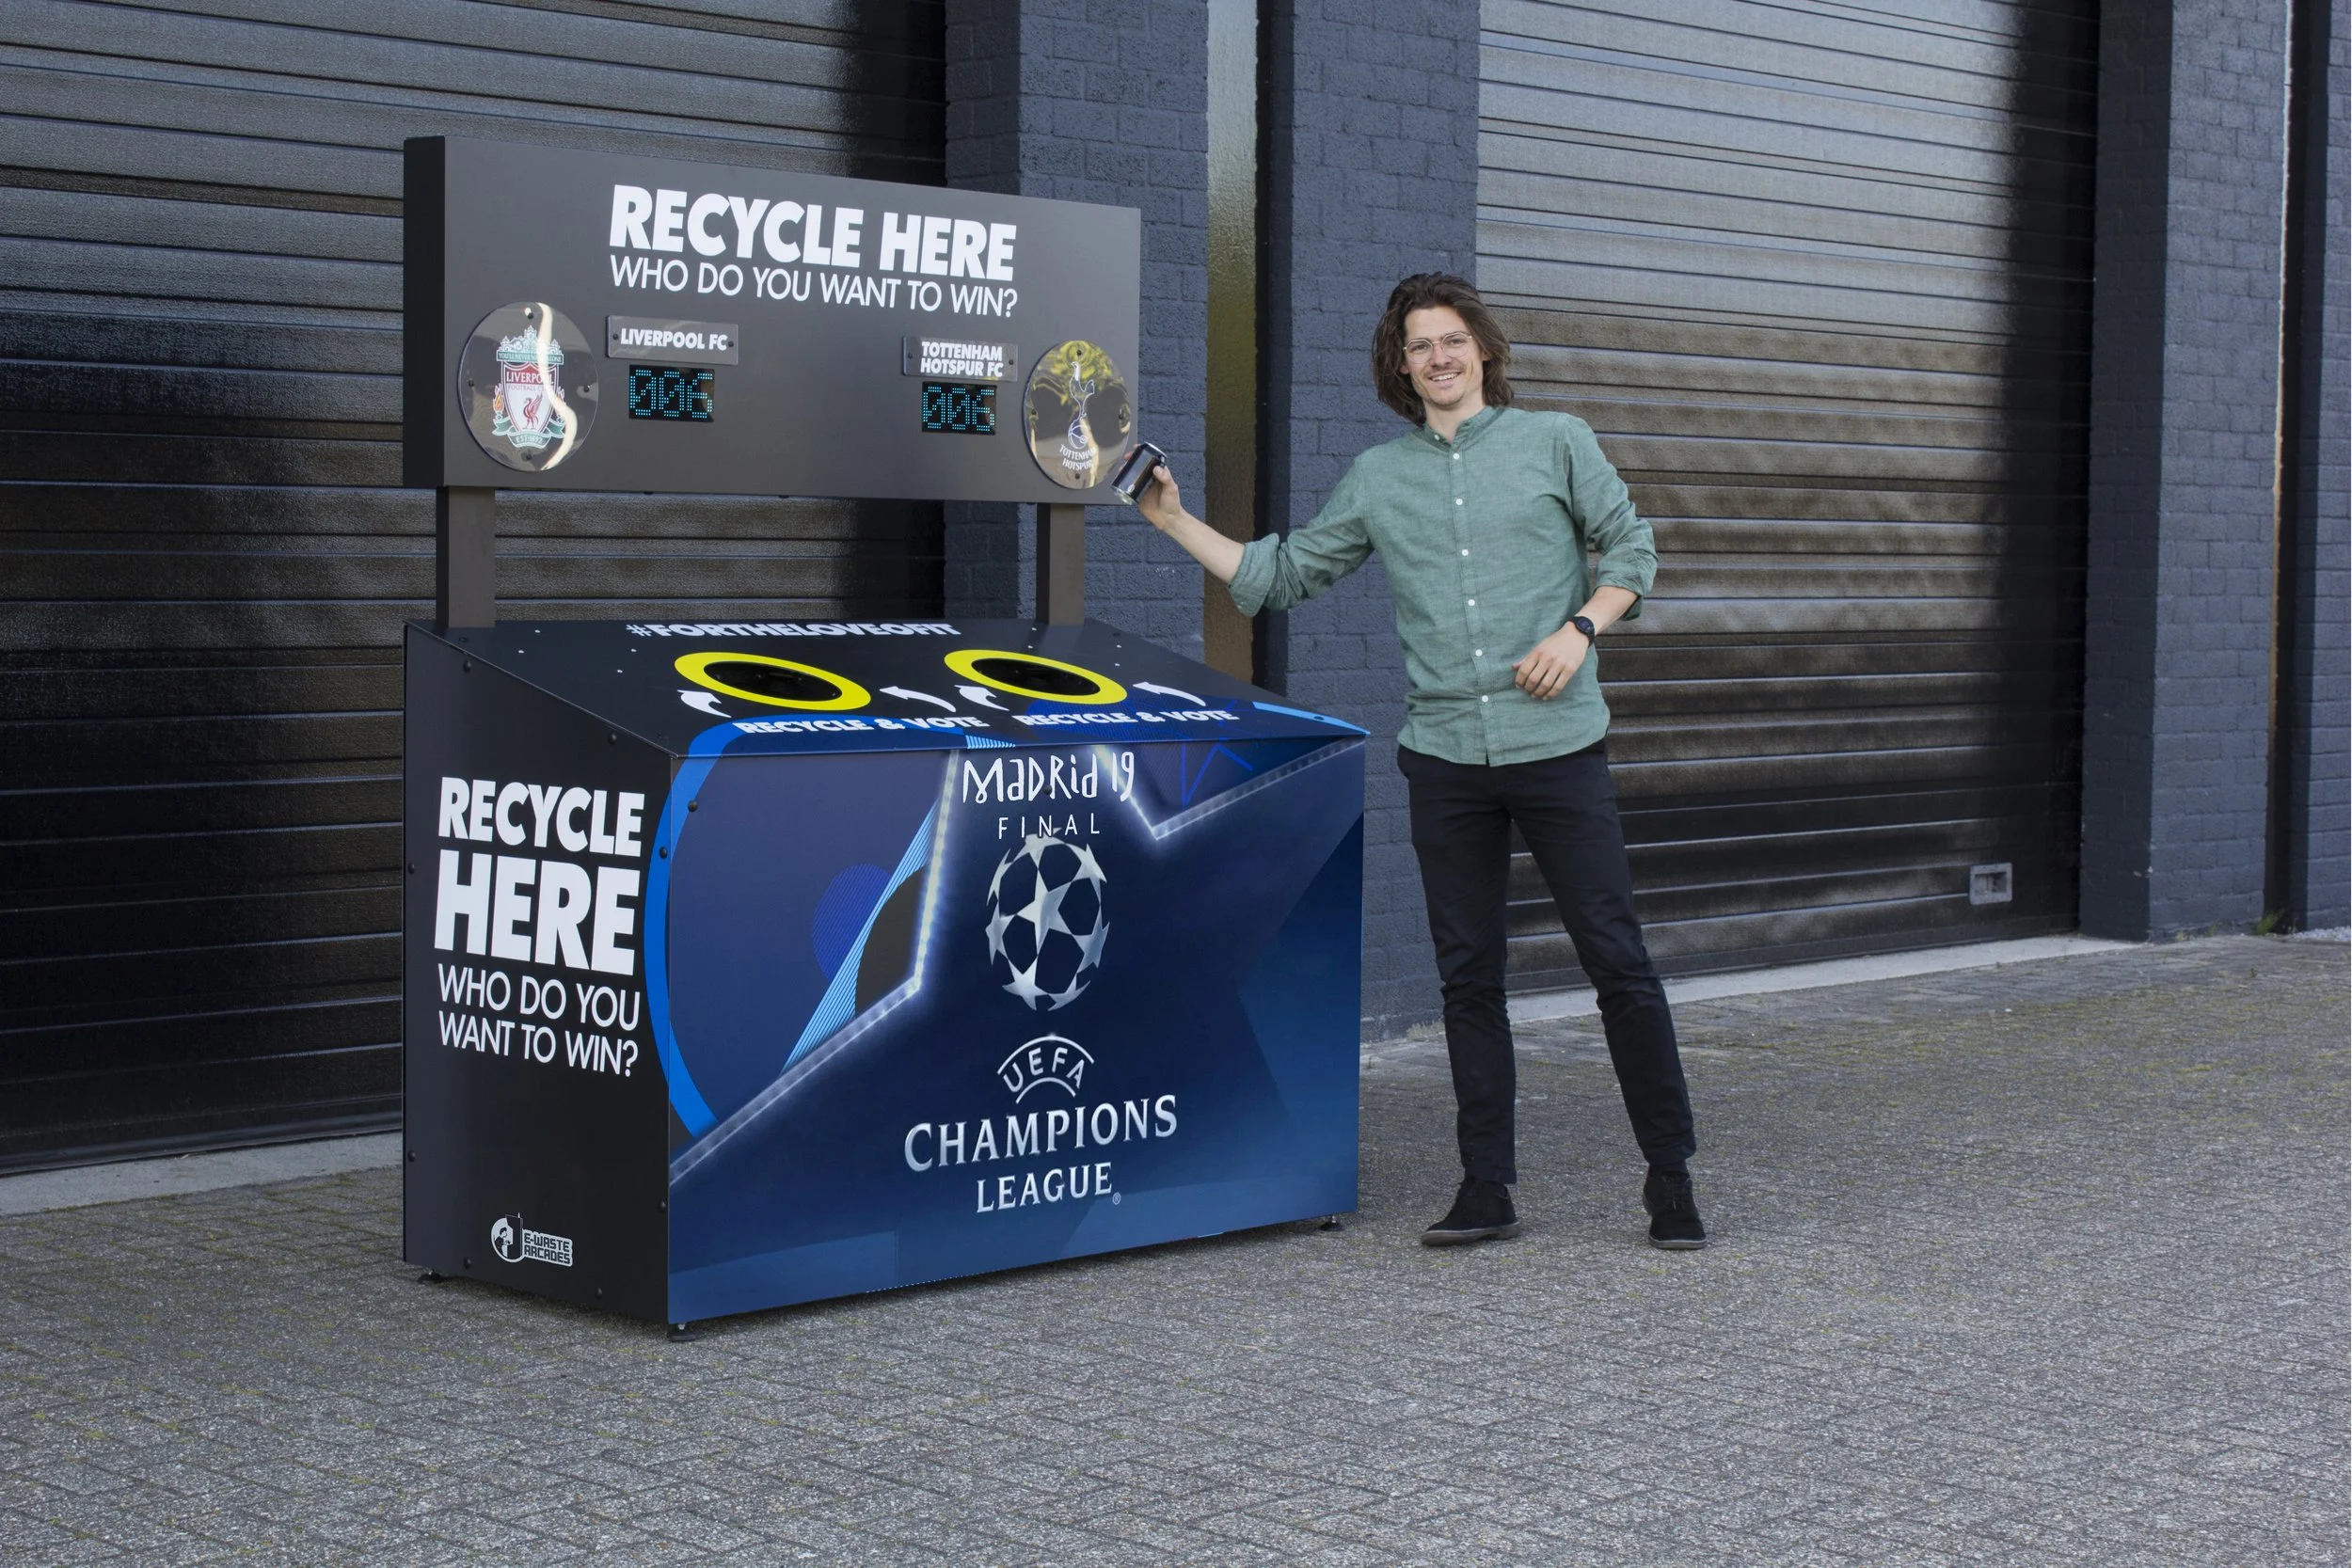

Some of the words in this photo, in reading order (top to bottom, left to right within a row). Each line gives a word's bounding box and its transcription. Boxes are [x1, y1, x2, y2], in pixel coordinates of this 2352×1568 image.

[609, 183, 865, 268] RECYCLE
[879, 212, 1017, 282] HERE
[609, 254, 689, 293] WHO
[697, 261, 743, 296] DO
[752, 266, 812, 302] YOU
[819, 272, 901, 309] WANT
[908, 279, 942, 312] TO
[950, 283, 1018, 319] WIN?
[621, 327, 706, 350] LIVERPOOL
[708, 334, 728, 351] FC
[921, 341, 1003, 362] TOTTENHAM
[506, 372, 554, 385] LIVERPOL
[920, 357, 984, 377] HOTSPUR
[987, 362, 1005, 378] FC
[629, 369, 713, 419] 006
[923, 386, 994, 432] 006
[626, 623, 961, 638] #FORTHELOVEOFIT
[732, 719, 875, 735] RECYCLE
[873, 718, 906, 730] &
[900, 716, 990, 730] VOTE
[1011, 712, 1138, 726] RECYCLE
[1136, 711, 1167, 722] &
[1158, 710, 1240, 722] VOTE
[1111, 751, 1135, 802] 19
[438, 776, 645, 858] RECYCLE
[998, 812, 1100, 840] FINAL
[434, 848, 641, 976] HERE
[437, 962, 511, 1011] WHO
[519, 975, 566, 1020] DO
[575, 982, 640, 1032] YOU
[438, 1009, 516, 1056] WANT
[521, 1023, 557, 1064] TO
[564, 1029, 639, 1078] WIN?
[1002, 1046, 1086, 1093] UEFA
[904, 1094, 1178, 1172] CHAMPIONS
[976, 1161, 1113, 1214] LEAGUE
[523, 1232, 570, 1253] E-WASTE
[523, 1244, 571, 1265] ARCADES
